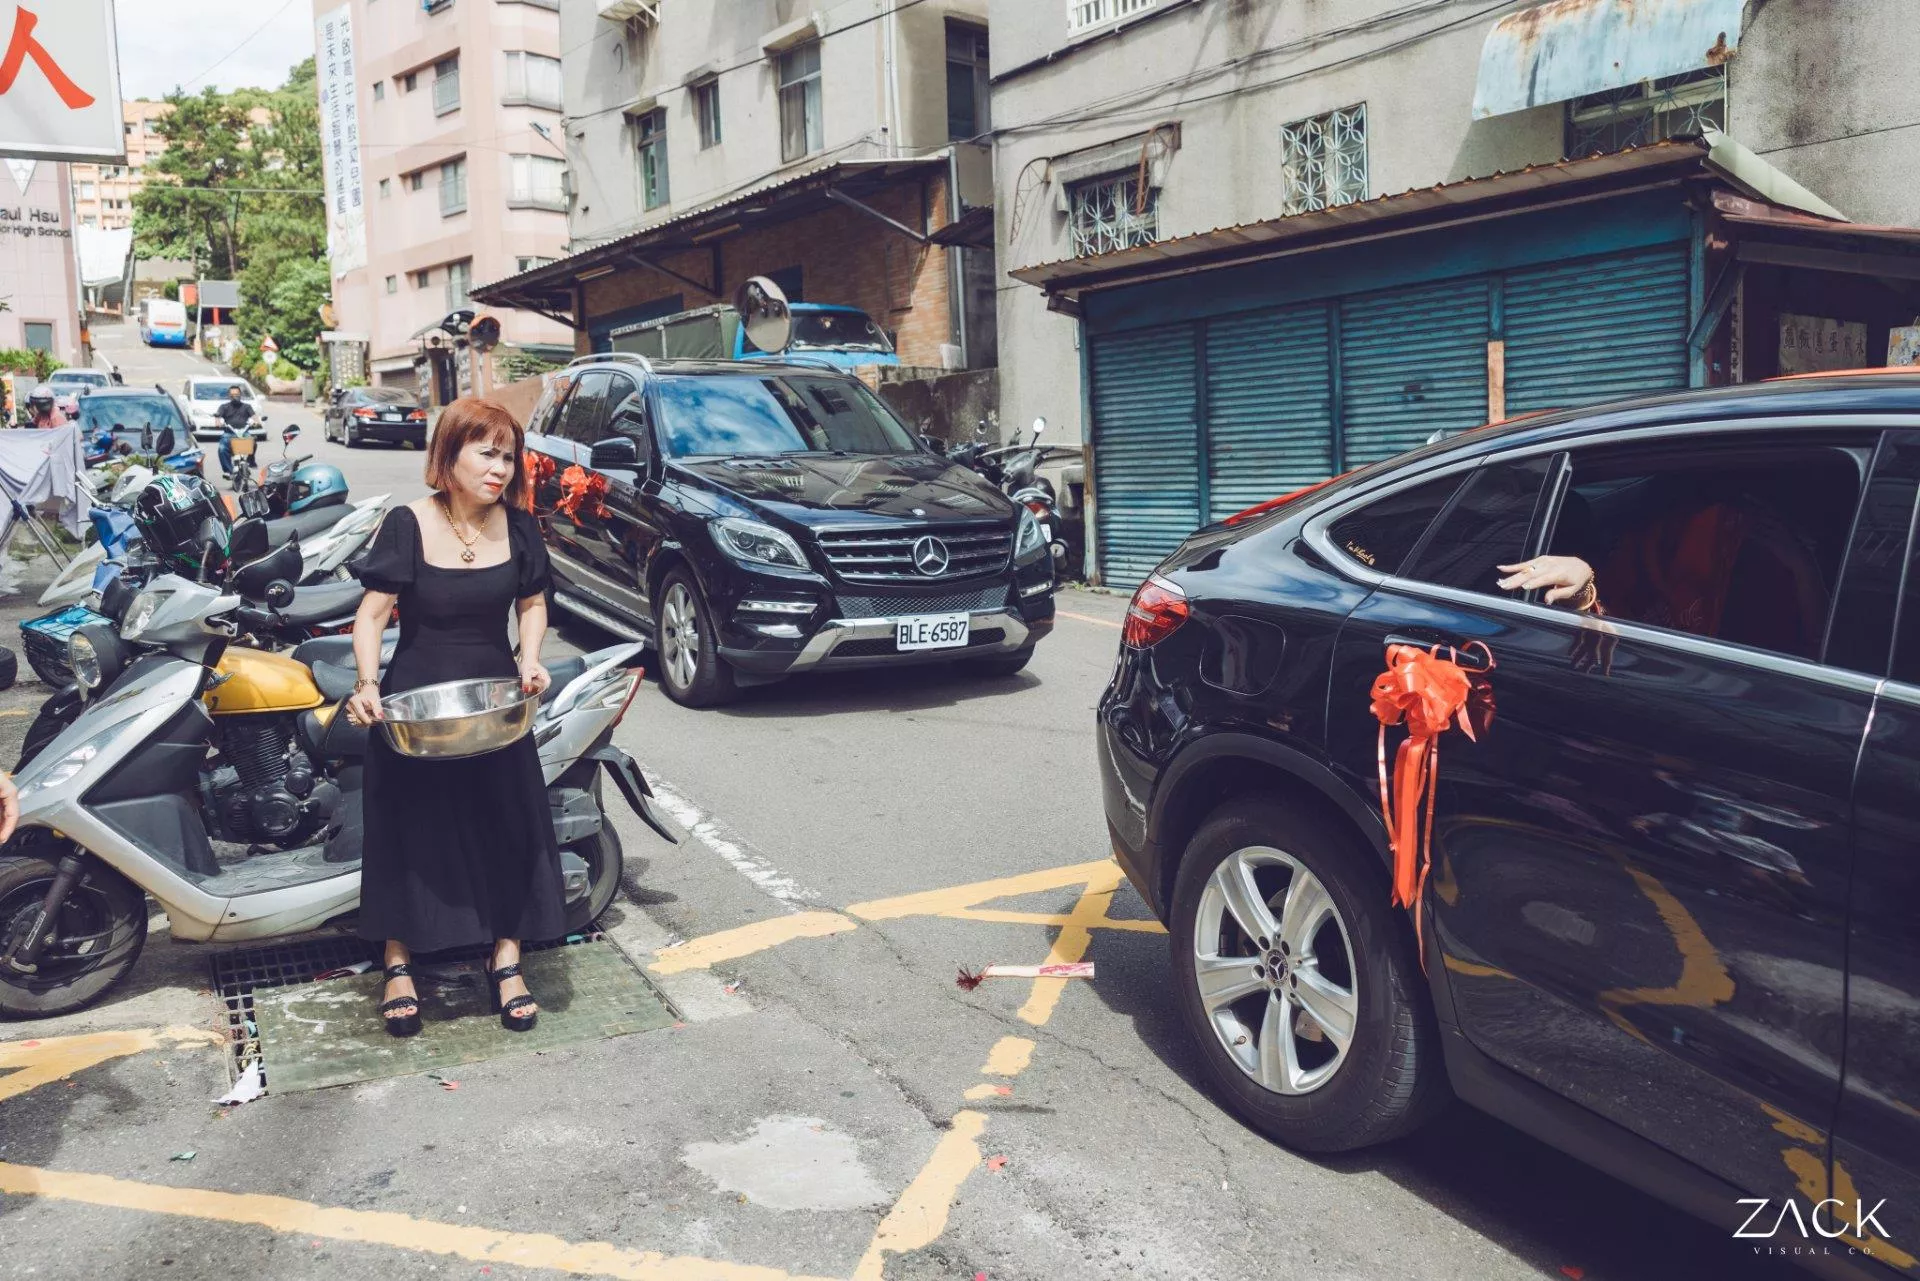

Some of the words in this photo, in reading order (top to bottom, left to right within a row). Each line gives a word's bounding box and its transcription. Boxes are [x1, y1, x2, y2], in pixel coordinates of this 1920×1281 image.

[0, 4, 95, 110] 人
[29, 208, 60, 223] Hsu
[13, 226, 36, 238] High
[37, 226, 72, 239] School
